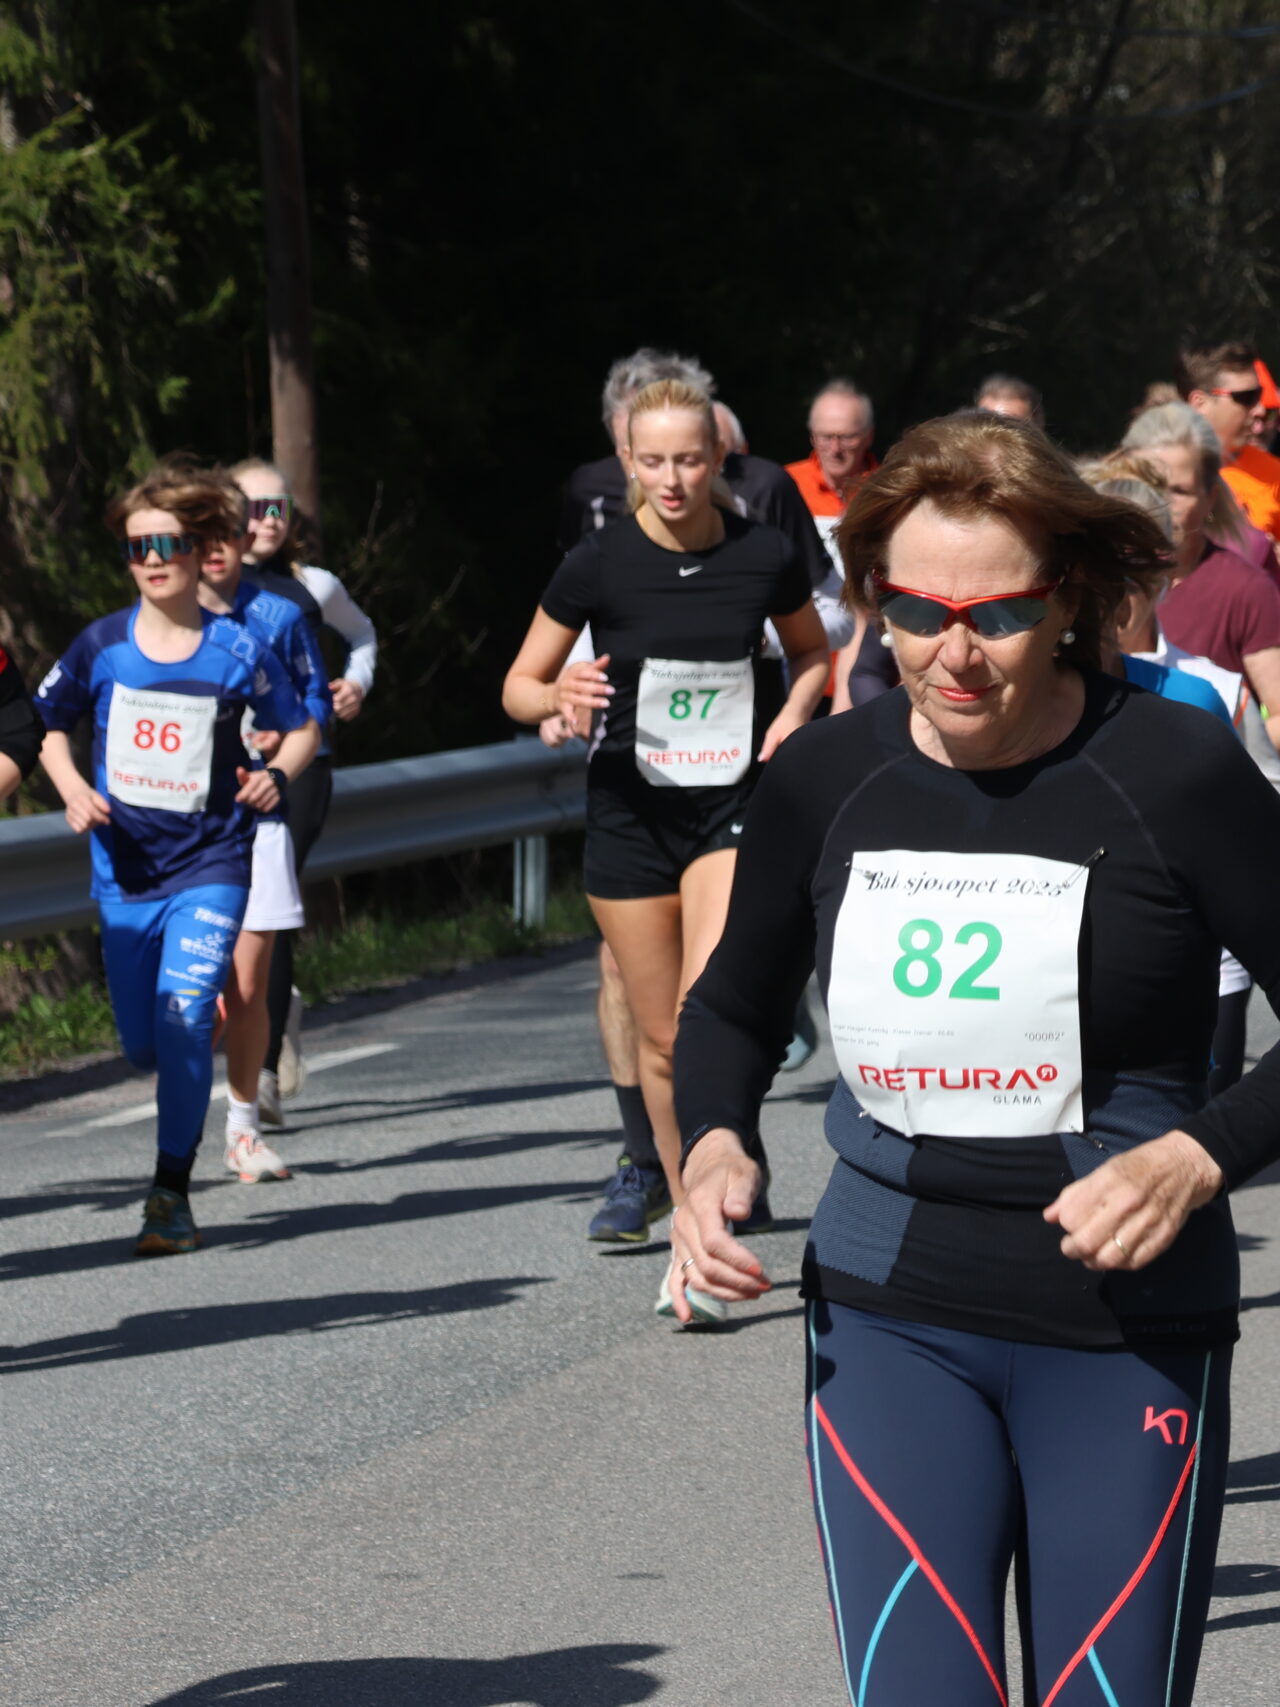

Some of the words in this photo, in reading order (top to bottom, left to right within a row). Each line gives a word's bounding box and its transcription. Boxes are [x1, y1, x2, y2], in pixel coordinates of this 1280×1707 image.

[668, 688, 722, 720] 87
[133, 718, 182, 754] 86
[647, 749, 733, 765] RETURA
[893, 918, 1003, 1000] 82
[858, 1064, 1039, 1092] RETURA
